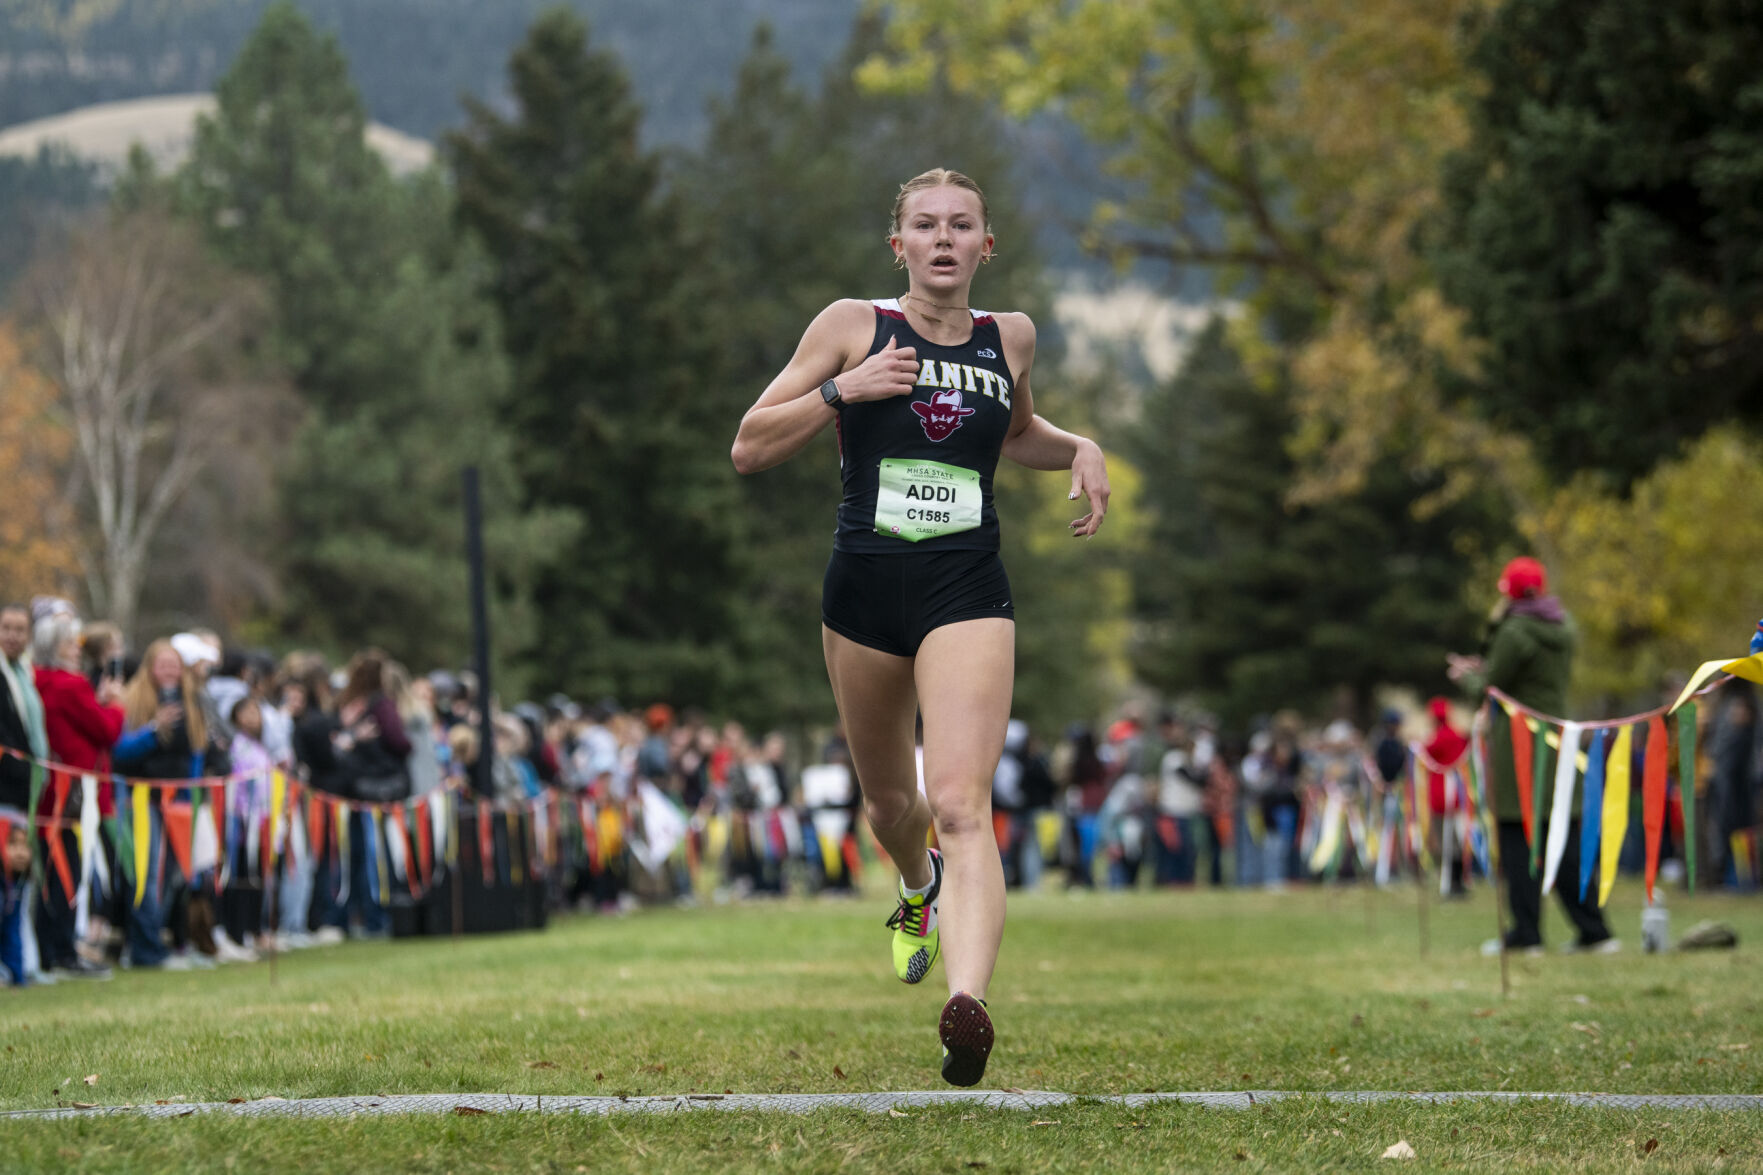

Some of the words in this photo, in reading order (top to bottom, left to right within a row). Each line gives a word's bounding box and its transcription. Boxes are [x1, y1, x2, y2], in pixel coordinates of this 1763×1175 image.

[912, 359, 1011, 411] ANITE
[932, 469, 955, 480] STATE
[906, 484, 956, 503] ADDI
[907, 508, 950, 523] C1585
